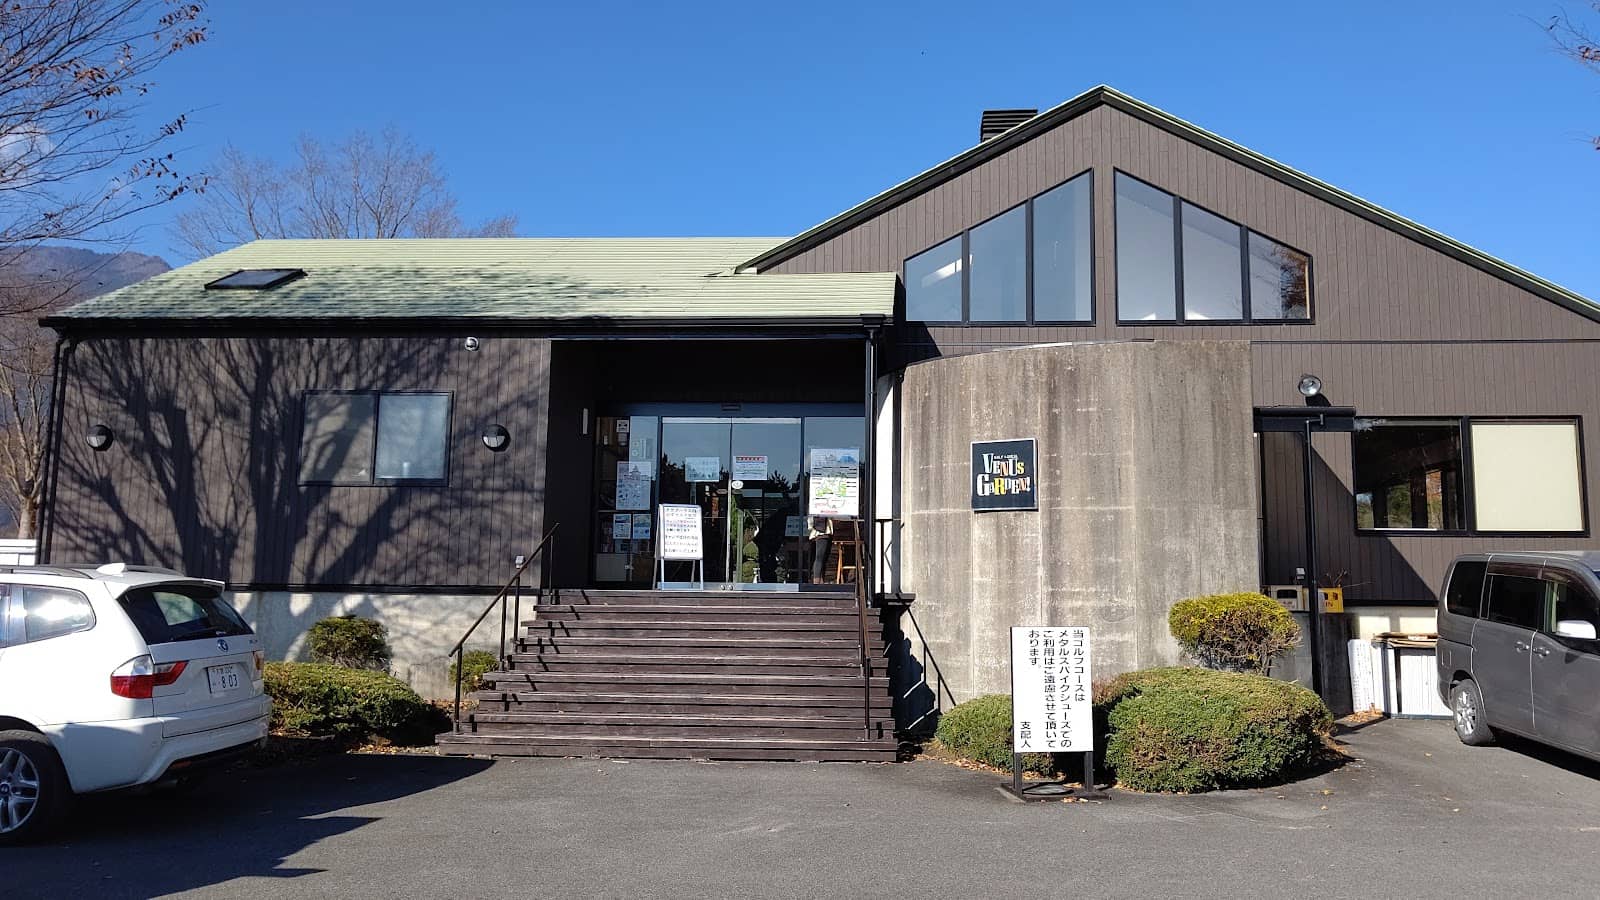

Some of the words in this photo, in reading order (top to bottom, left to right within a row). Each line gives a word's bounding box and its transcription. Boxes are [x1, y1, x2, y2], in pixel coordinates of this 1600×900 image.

[982, 453, 1024, 476] VENUS
[1043, 630, 1057, 749] ご利用はご遠慮させて頂いて
[1059, 629, 1072, 749] メタルスパイクシューズでの
[1073, 629, 1085, 702] 当ゴルフコースは
[1020, 721, 1032, 749] 支配人
